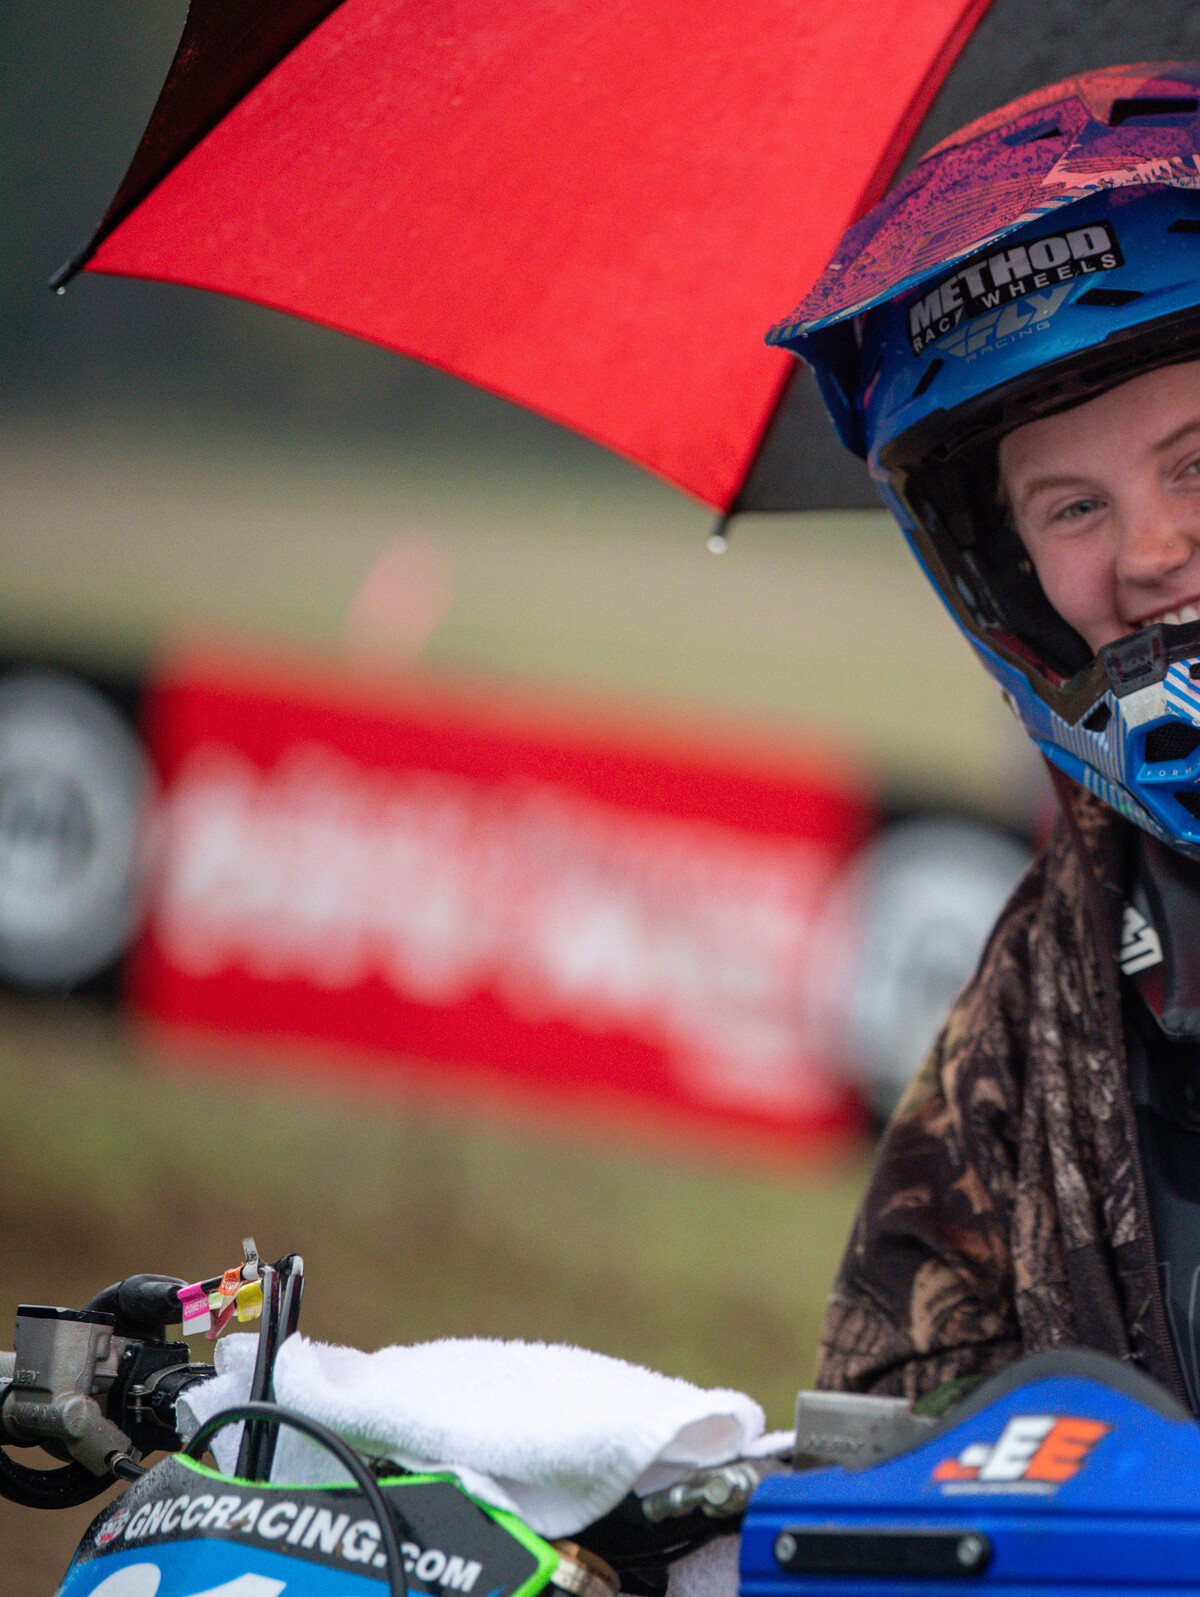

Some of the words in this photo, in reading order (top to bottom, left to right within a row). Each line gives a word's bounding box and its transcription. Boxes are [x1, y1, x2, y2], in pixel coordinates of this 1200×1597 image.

[910, 225, 1112, 338] METHOD
[980, 253, 1118, 308] WHEELS
[938, 281, 1074, 358] FLY
[965, 320, 1051, 363] RACING
[124, 1495, 482, 1592] GNCCRACING.COM
